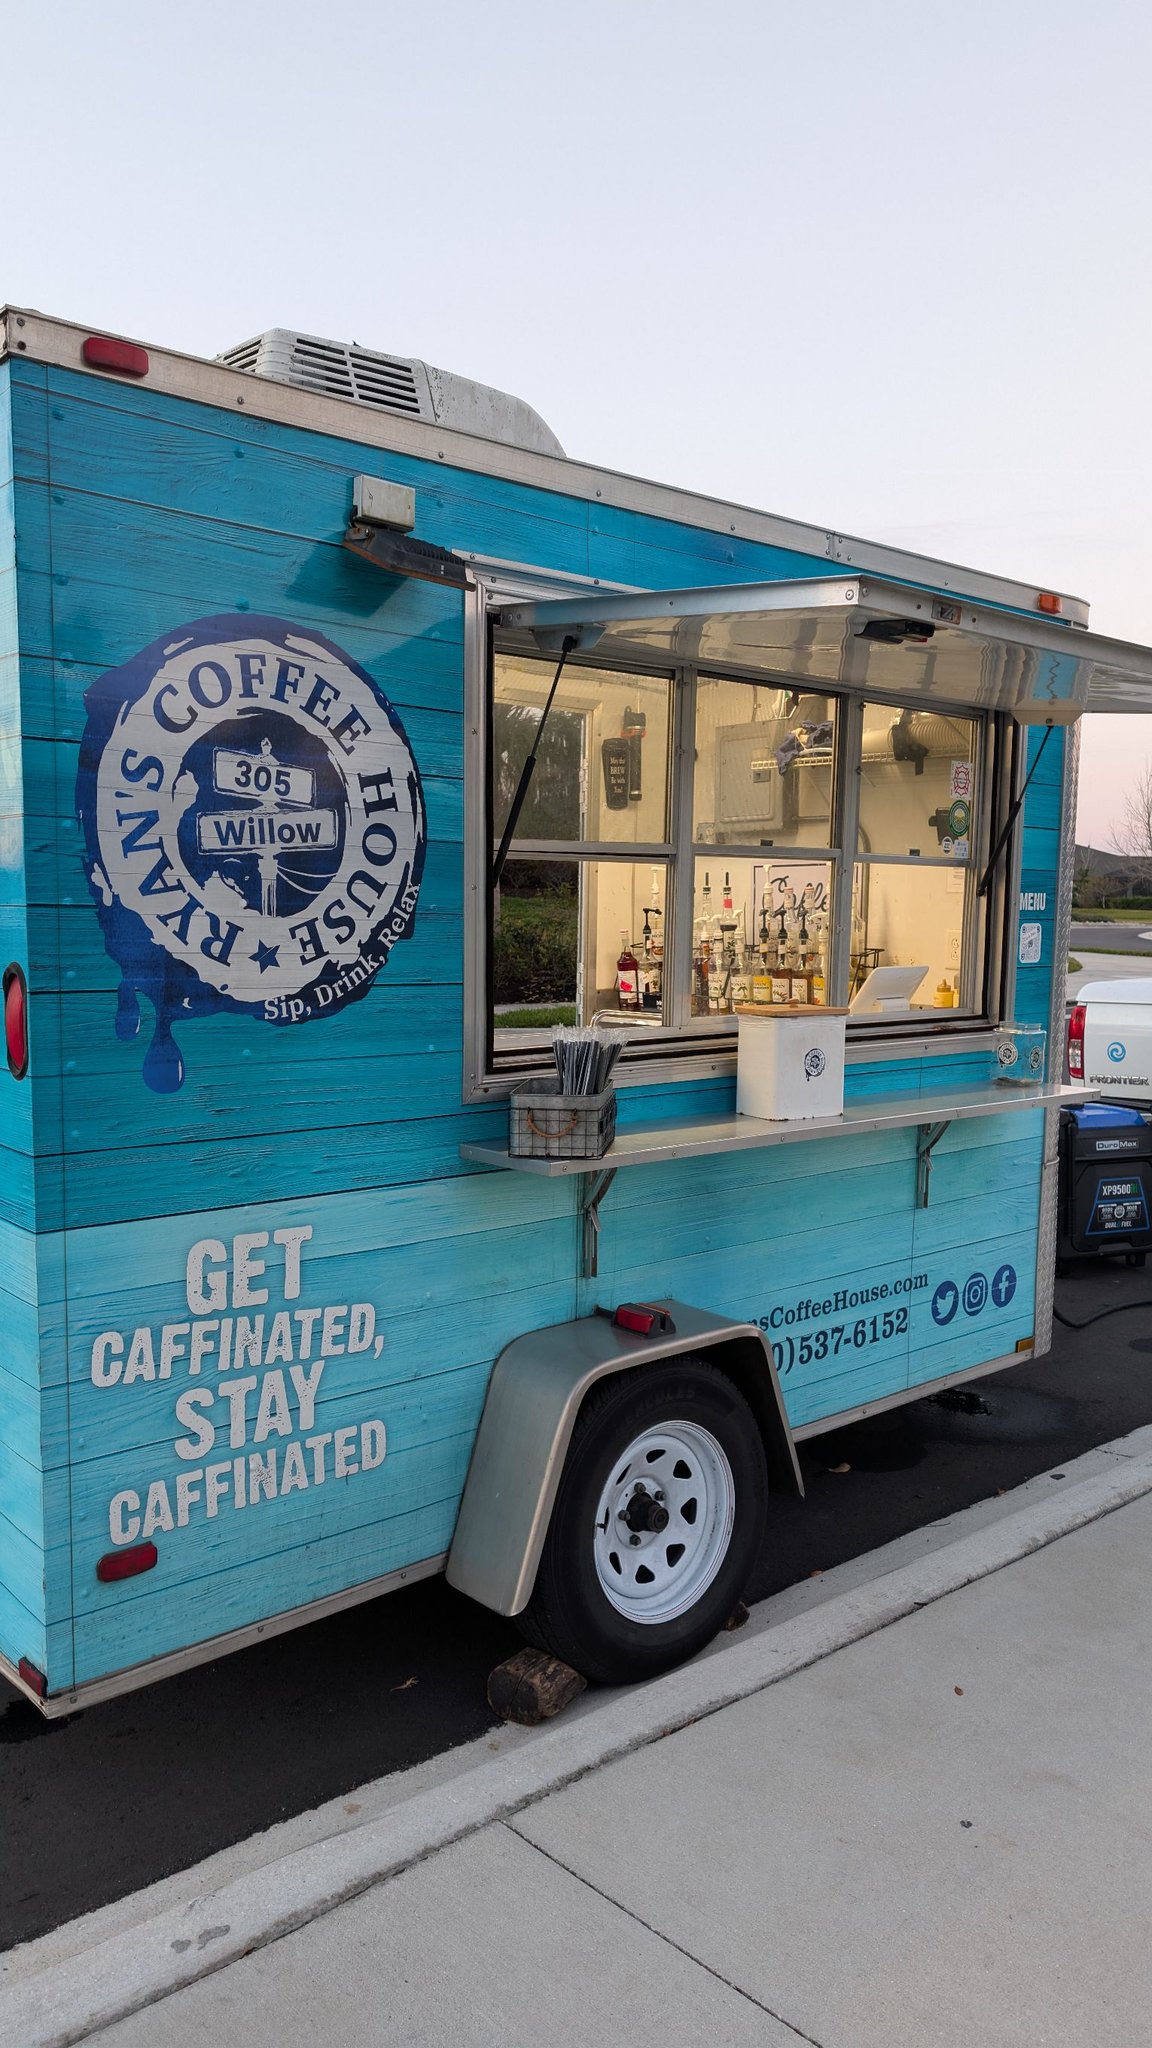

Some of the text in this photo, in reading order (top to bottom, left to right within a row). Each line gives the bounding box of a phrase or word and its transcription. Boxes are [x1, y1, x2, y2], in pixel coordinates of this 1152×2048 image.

[234, 760, 292, 797] 305
[610, 766, 625, 775] BREW
[116, 653, 399, 968] RYAN'S COFFEE HOUSE
[214, 816, 322, 846] Willow
[1019, 892, 1047, 911] MENU
[264, 883, 421, 1022] Sip, Drink, Relax
[1089, 1073, 1150, 1087] FRONTIER
[1096, 1140, 1138, 1150] DuroMax
[186, 1225, 313, 1315] GET
[91, 1303, 384, 1388] CAFFINATED,
[174, 1360, 325, 1460] STAY
[109, 1419, 387, 1546] CAFFINATED
